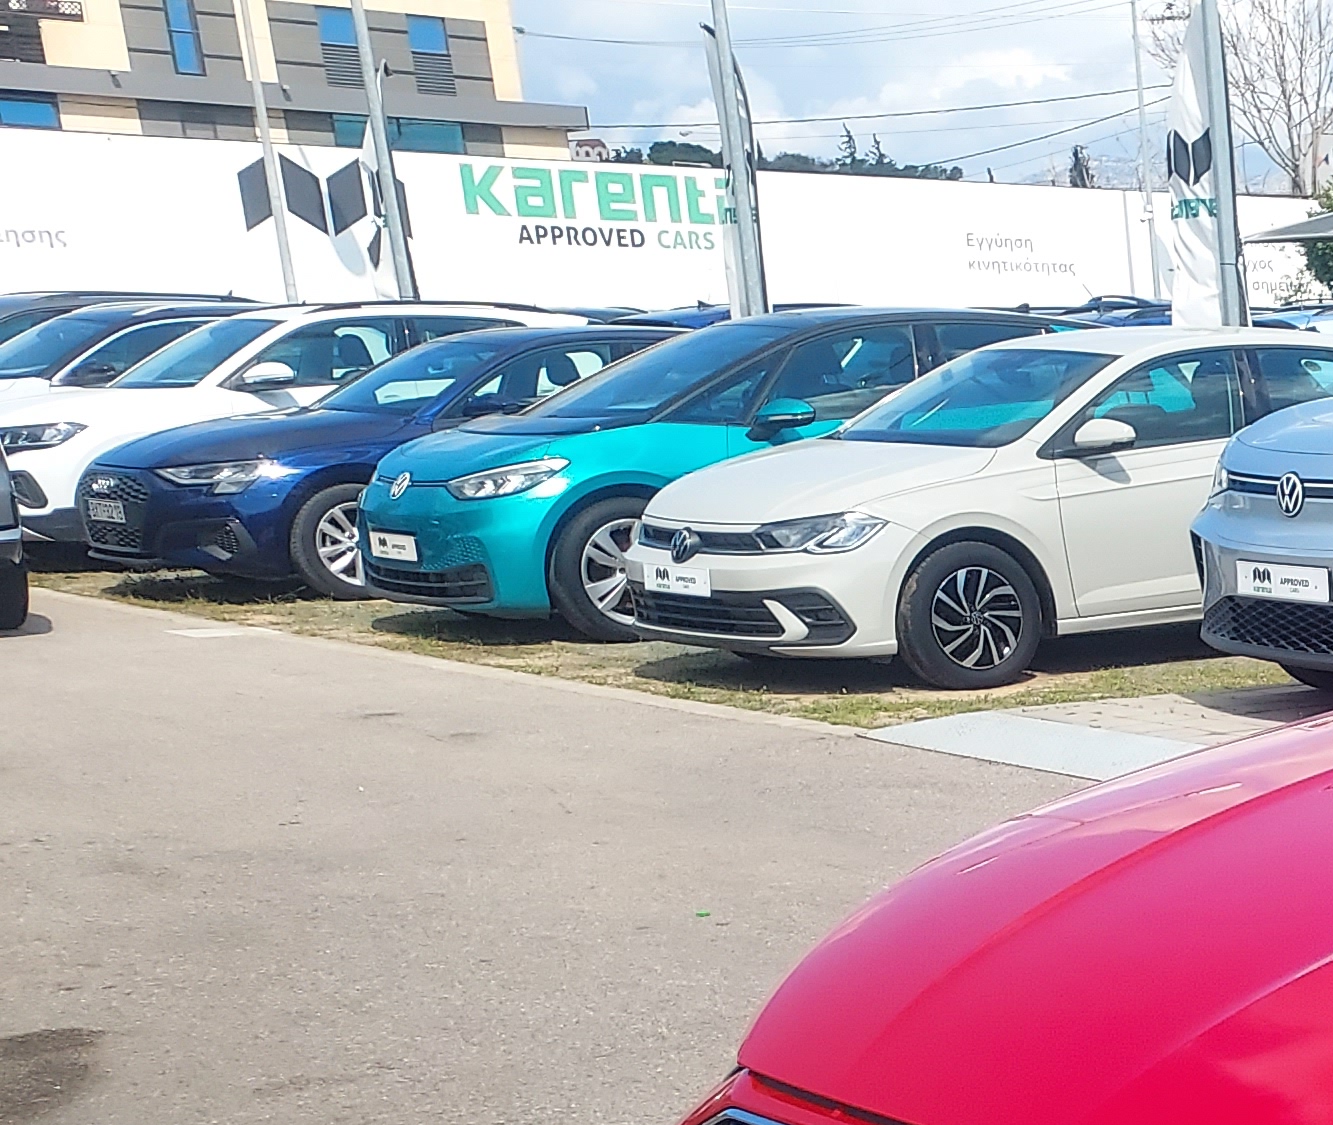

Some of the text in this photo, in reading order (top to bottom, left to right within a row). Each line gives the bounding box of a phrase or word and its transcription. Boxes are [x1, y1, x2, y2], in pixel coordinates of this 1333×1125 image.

[518, 224, 715, 250] APPROVED CARS
[966, 232, 1034, 253] Εγγύηση
[968, 256, 1076, 276] κινητικότητας
